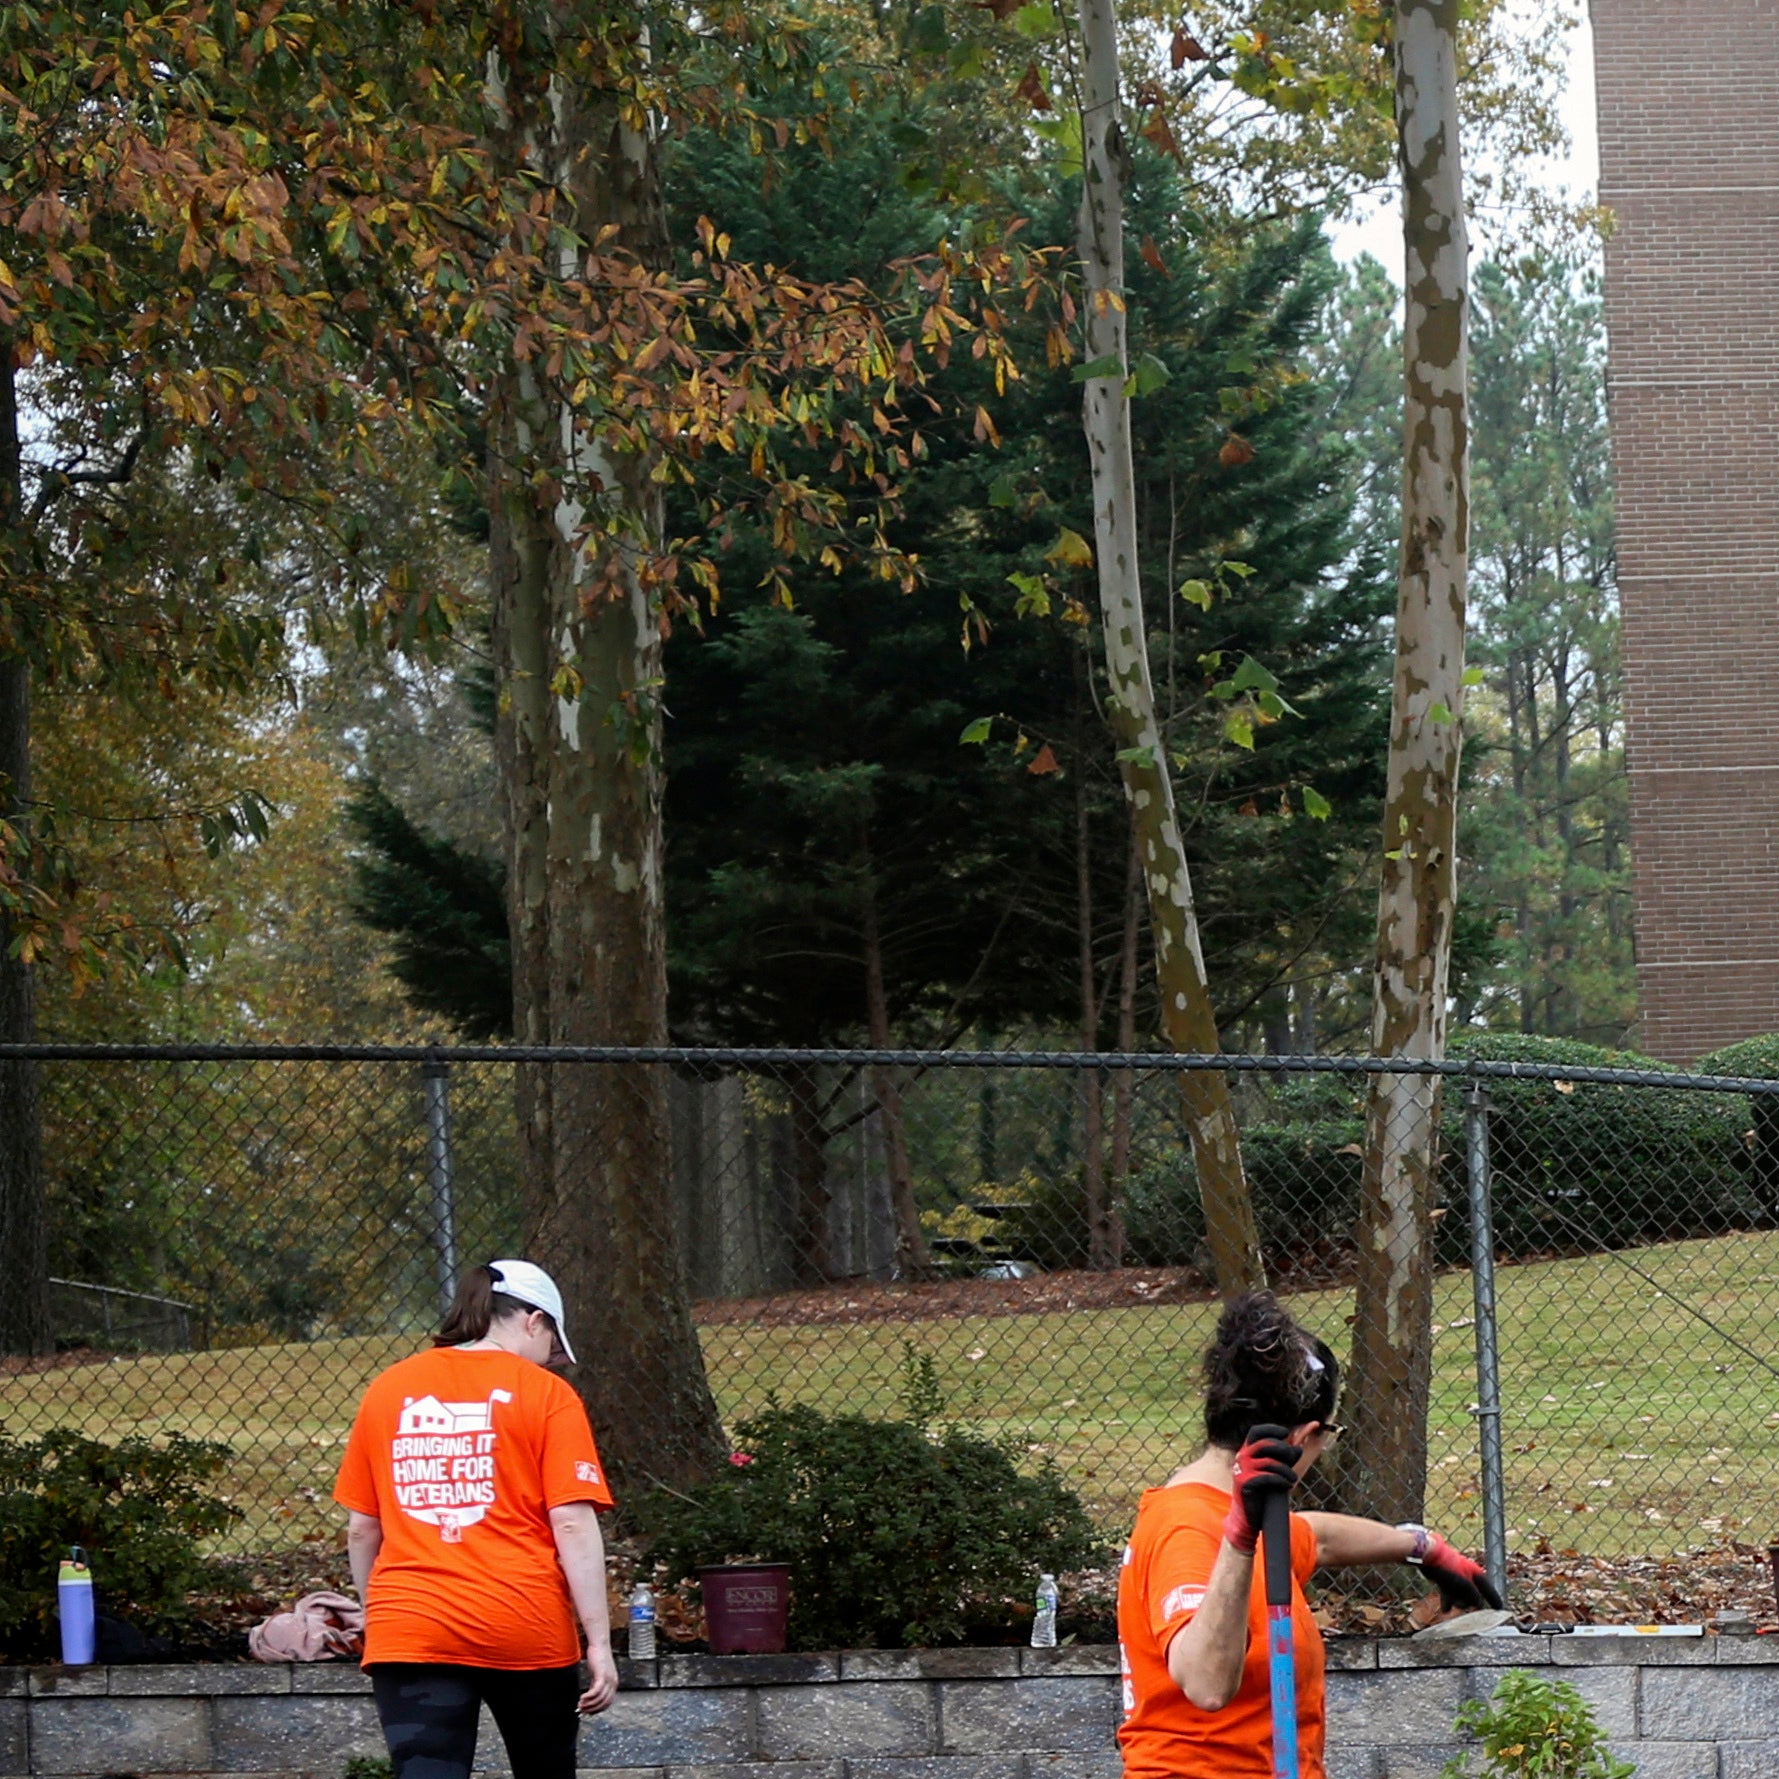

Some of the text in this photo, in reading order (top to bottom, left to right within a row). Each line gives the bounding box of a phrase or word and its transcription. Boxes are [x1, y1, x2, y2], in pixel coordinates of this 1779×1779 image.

[393, 1433, 496, 1459] BRINGING IT
[394, 1457, 494, 1483] HOME FOR
[395, 1481, 496, 1507] VETERANS
